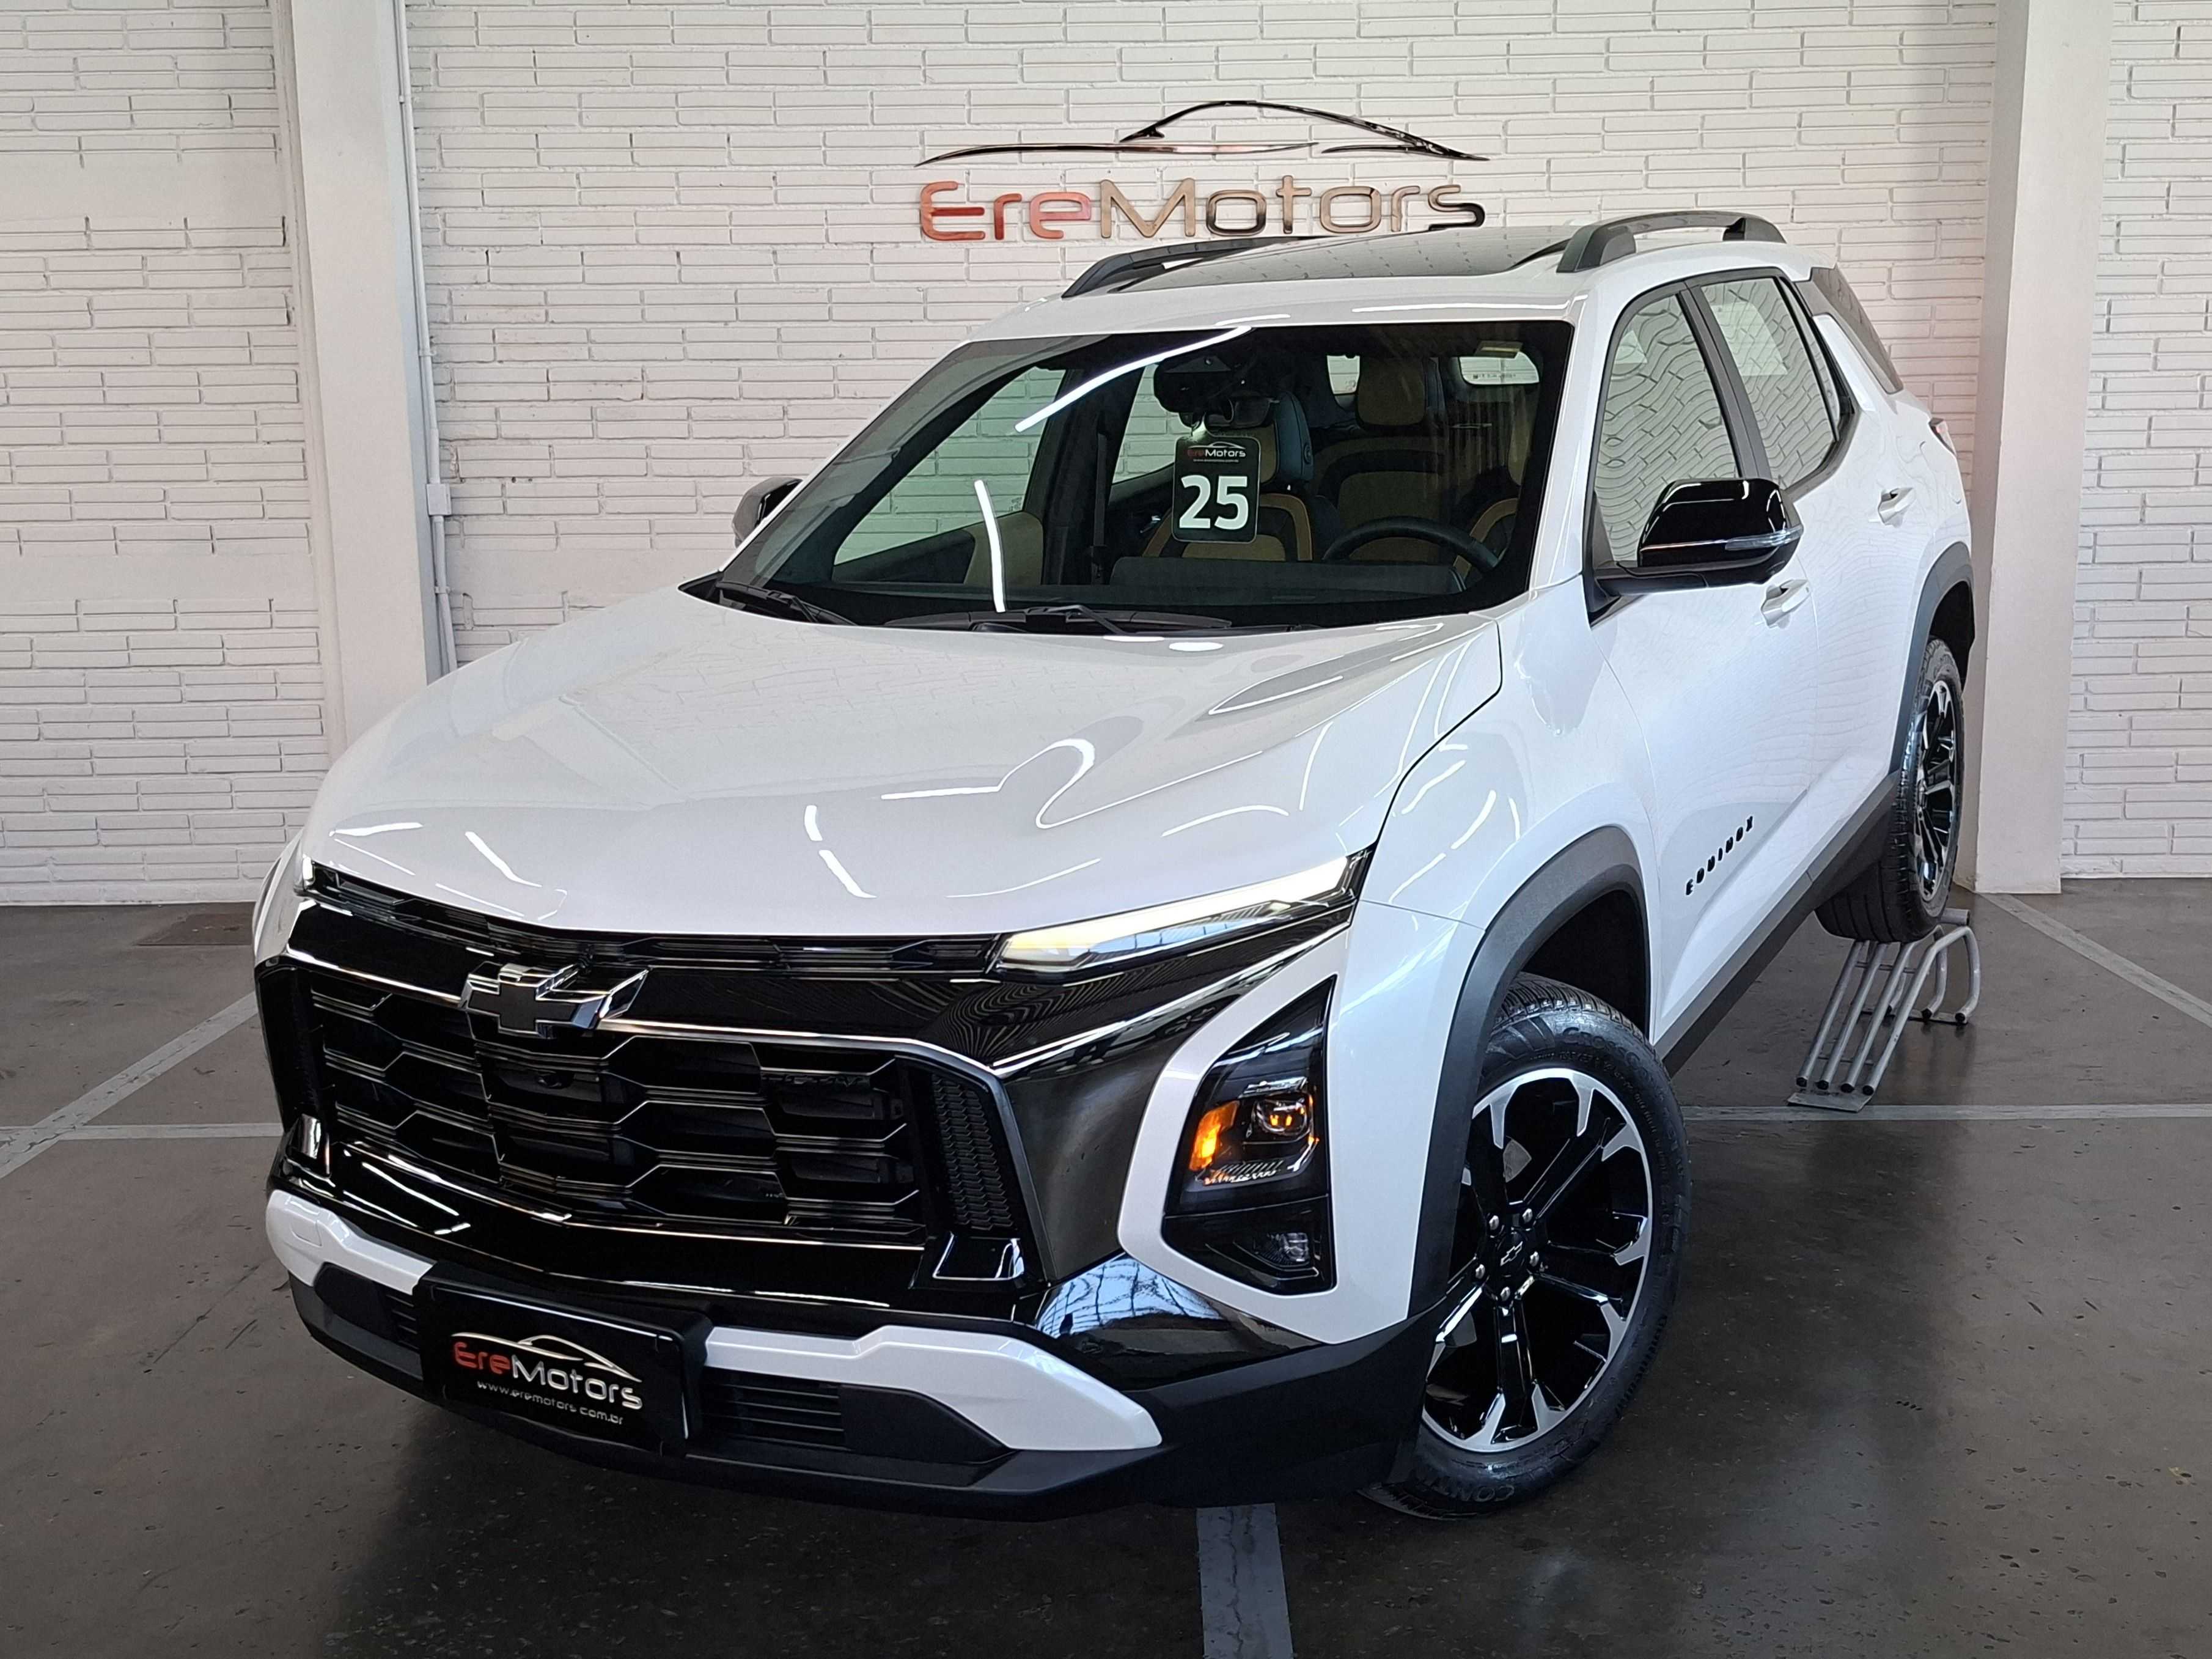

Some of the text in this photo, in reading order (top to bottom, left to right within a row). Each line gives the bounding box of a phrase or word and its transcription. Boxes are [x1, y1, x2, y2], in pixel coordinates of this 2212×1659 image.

[920, 175, 1485, 241] EreMotors
[1179, 474, 1249, 530] 25
[454, 1342, 642, 1410] EreMotors
